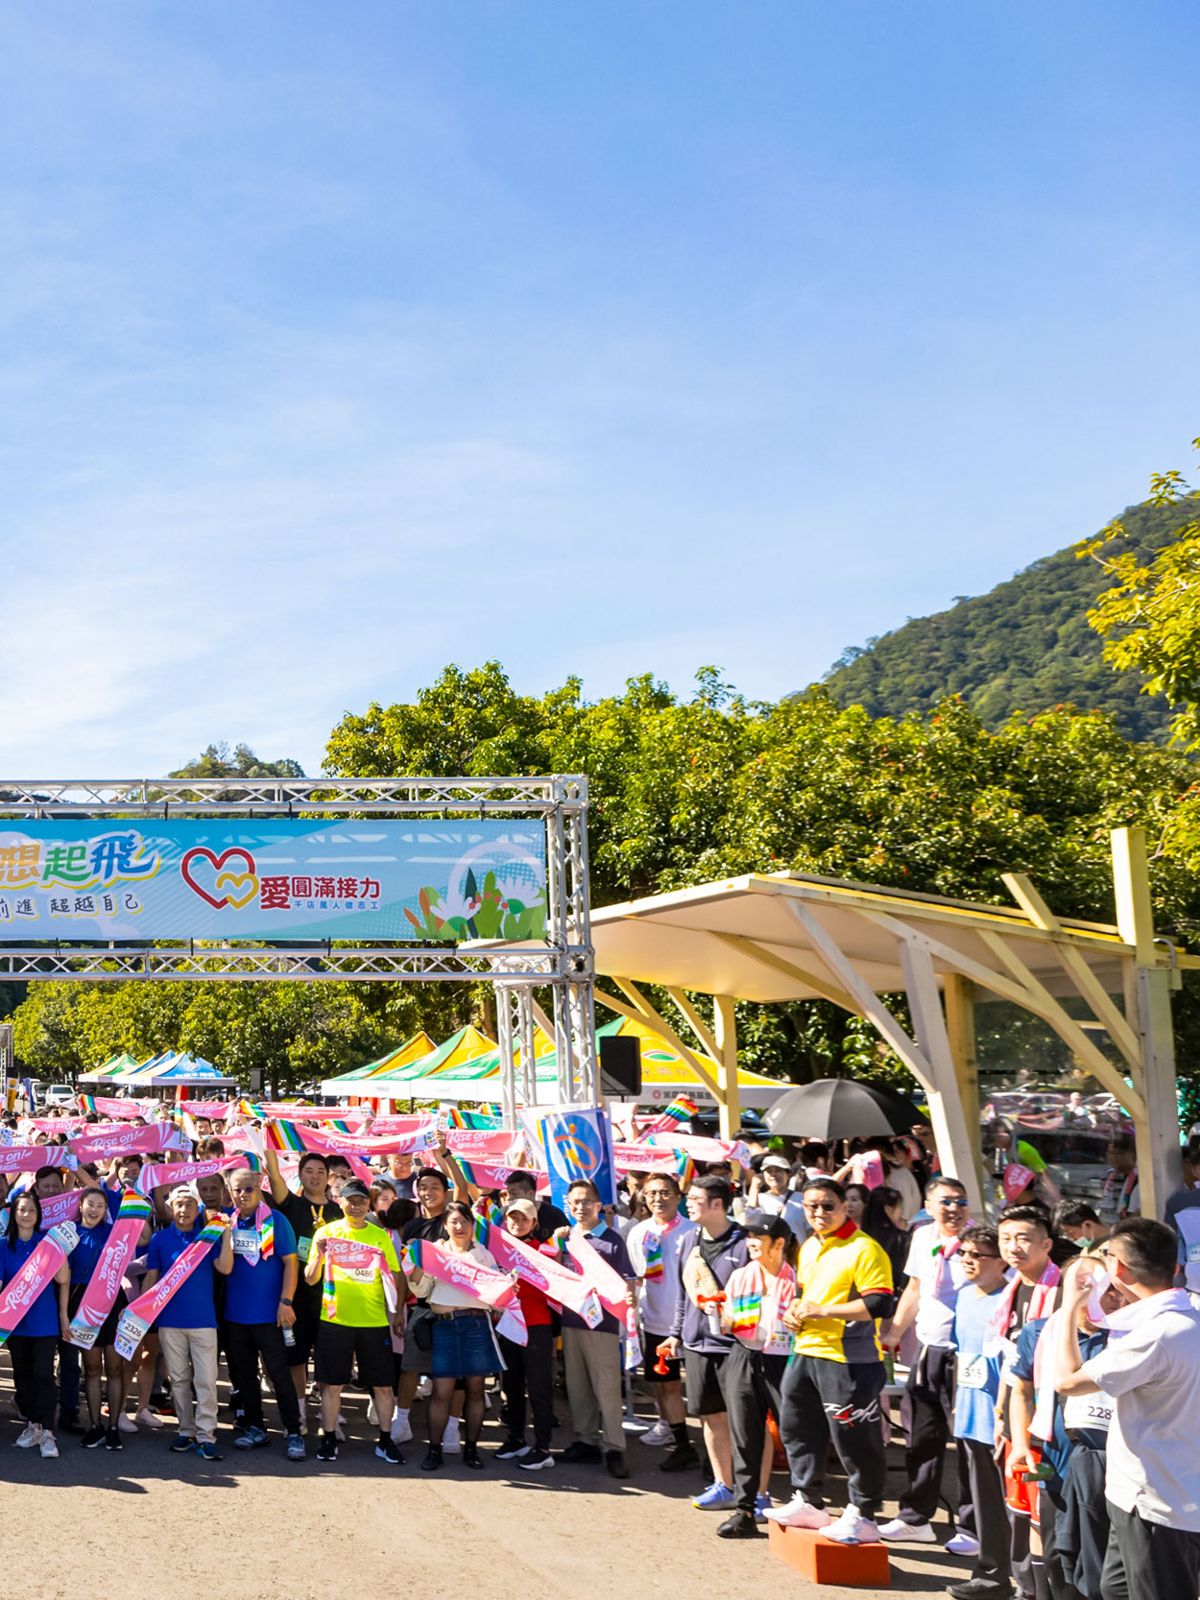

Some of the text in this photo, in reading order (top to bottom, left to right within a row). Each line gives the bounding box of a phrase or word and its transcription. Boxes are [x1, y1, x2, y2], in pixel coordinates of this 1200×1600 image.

[260, 876, 380, 909] 愛圓滿接力
[50, 894, 140, 914] 超越自己
[92, 1132, 140, 1151] Rise on!
[6, 1150, 26, 1162] on!
[53, 1197, 71, 1213] on!
[107, 1240, 129, 1296] Rise on!
[170, 1260, 192, 1287] Rise
[5, 1282, 27, 1310] Rise
[24, 1258, 40, 1283] on!
[124, 1322, 143, 1338] 2326
[1087, 1405, 1114, 1421] 228
